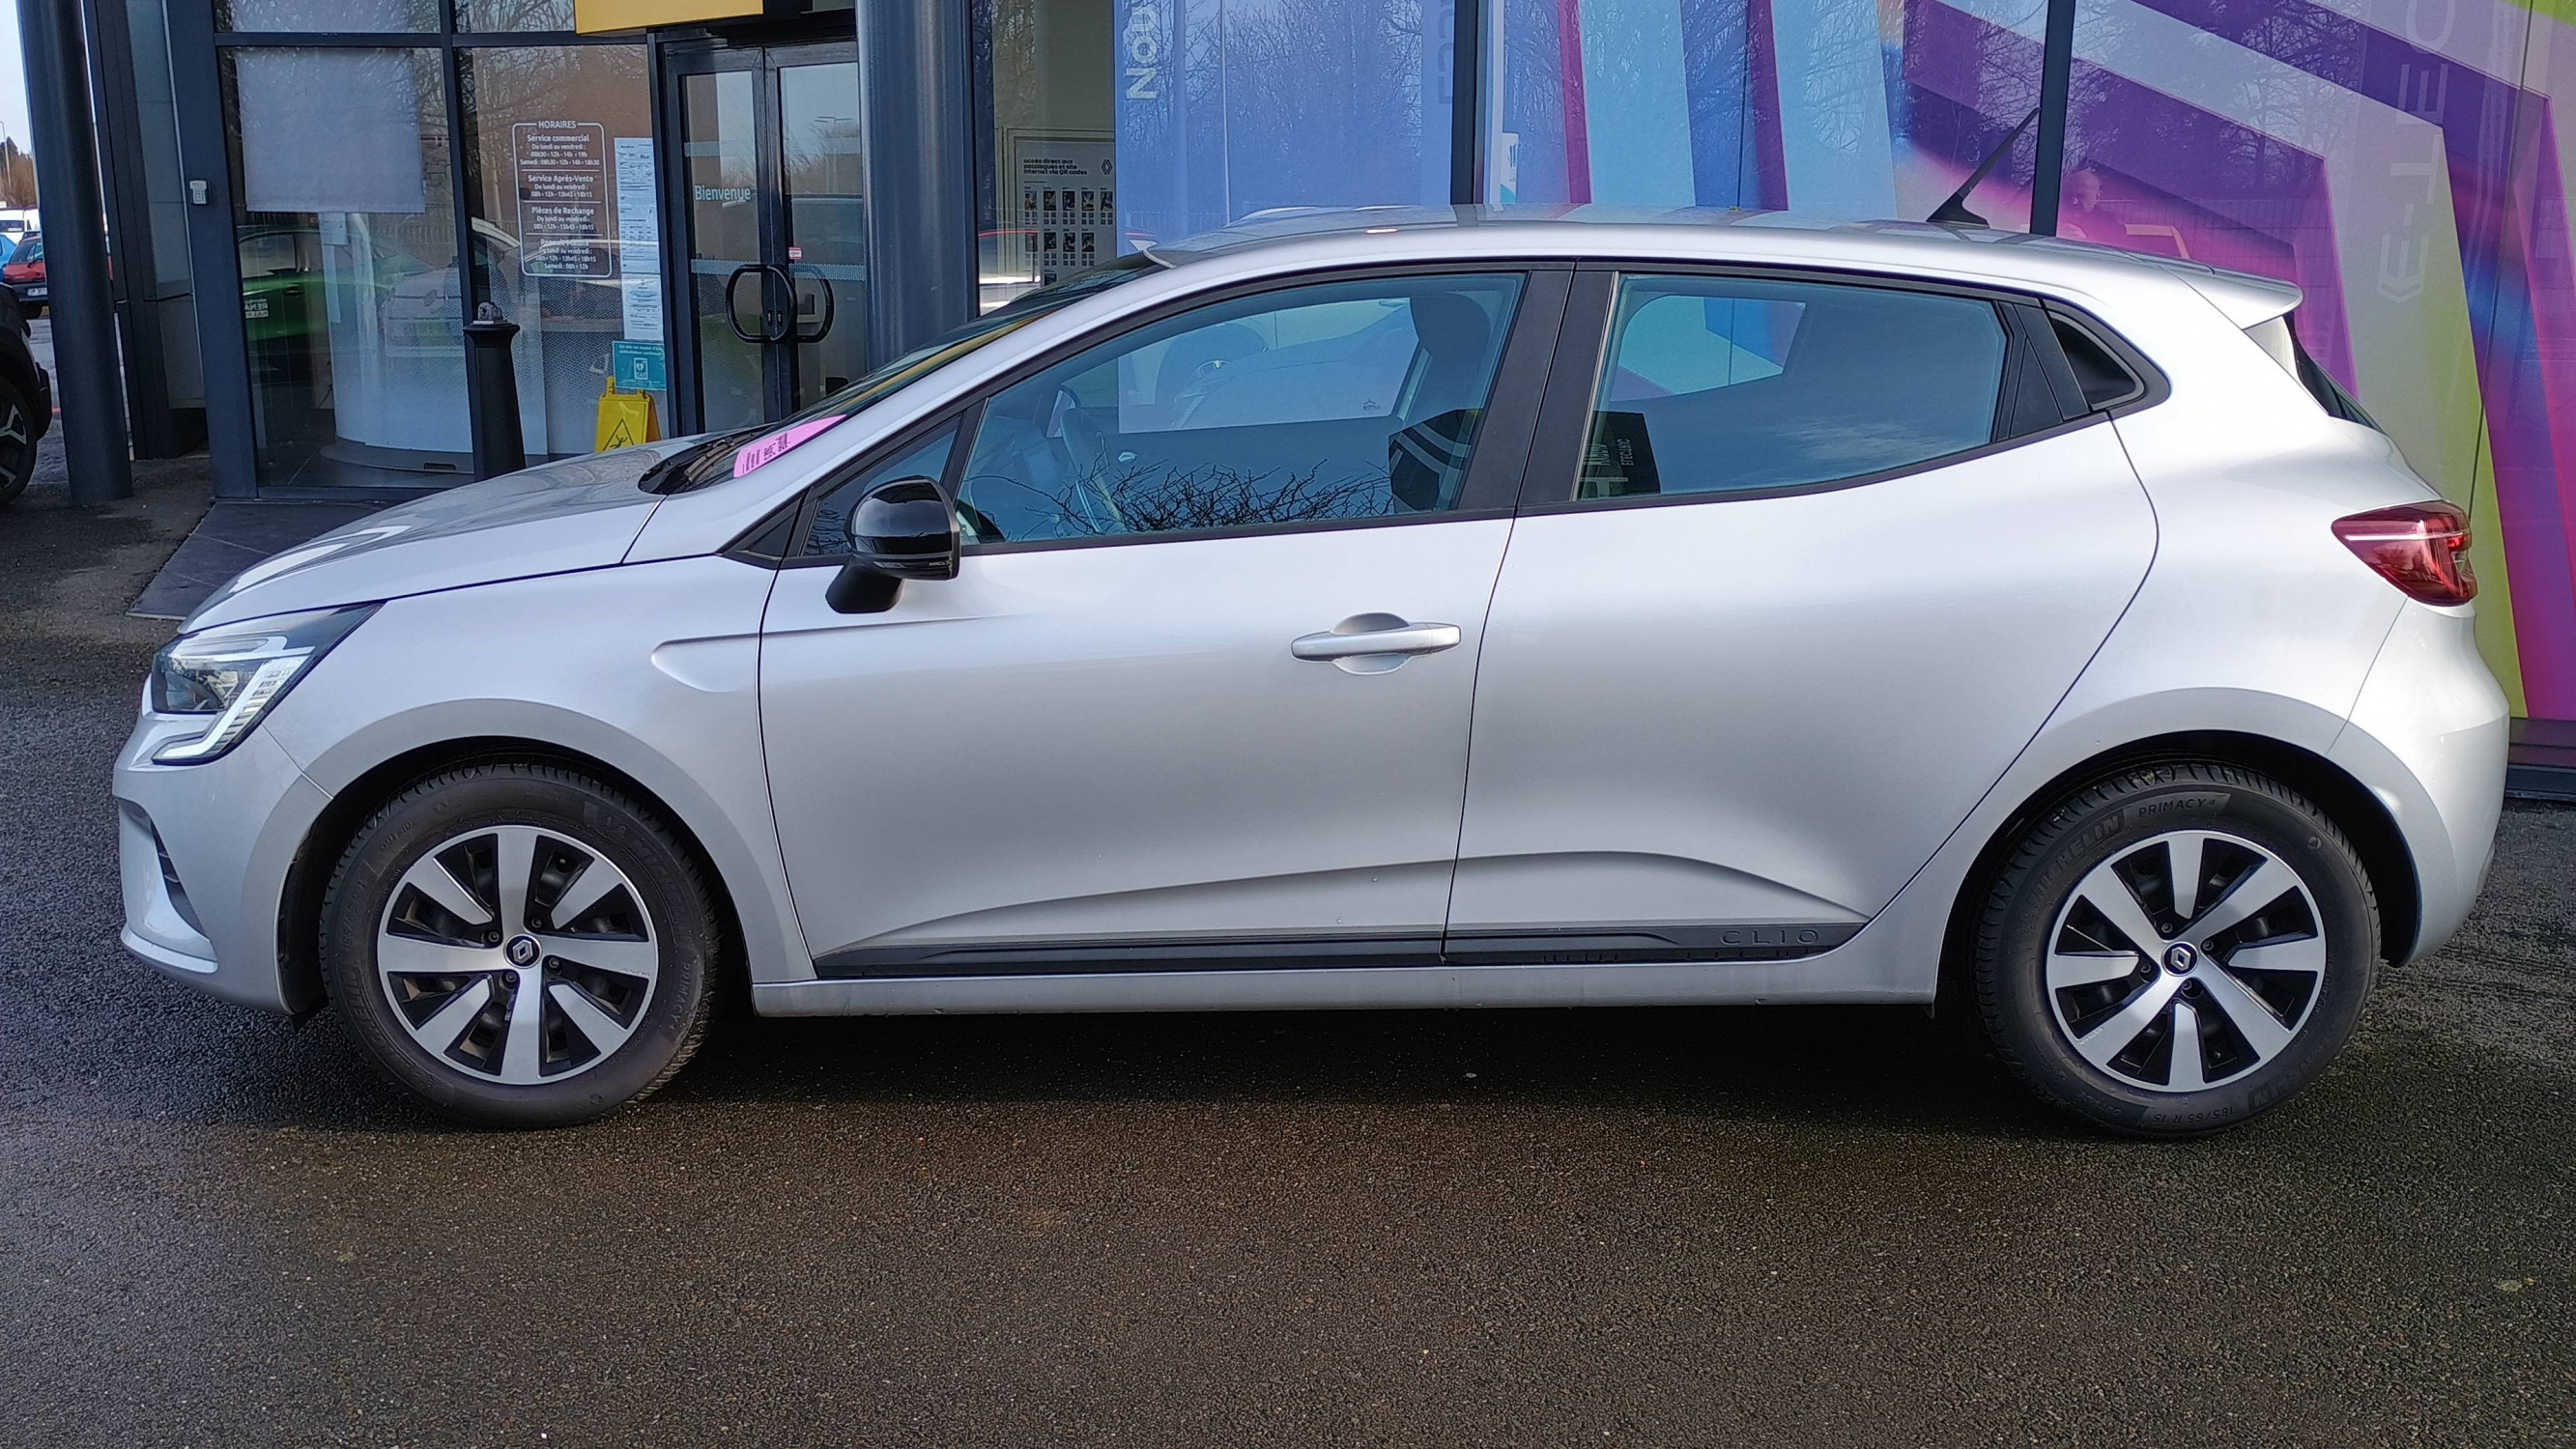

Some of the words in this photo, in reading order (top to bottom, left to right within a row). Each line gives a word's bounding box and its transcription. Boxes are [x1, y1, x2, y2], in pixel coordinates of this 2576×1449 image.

[538, 120, 576, 129] HORAIRES
[553, 175, 594, 183] Après-Vente
[694, 185, 751, 201] Bienvenue
[532, 206, 552, 214] Pièces
[554, 206, 561, 214] de
[563, 207, 595, 216] Rechange
[2139, 798, 2206, 818] PRIMACY
[1720, 929, 1819, 945] CLIO
[673, 962, 692, 1024] PRIMACY
[2153, 1113, 2166, 1122] 15
[2173, 1114, 2182, 1123] R
[2188, 1106, 2233, 1121] 185/65
